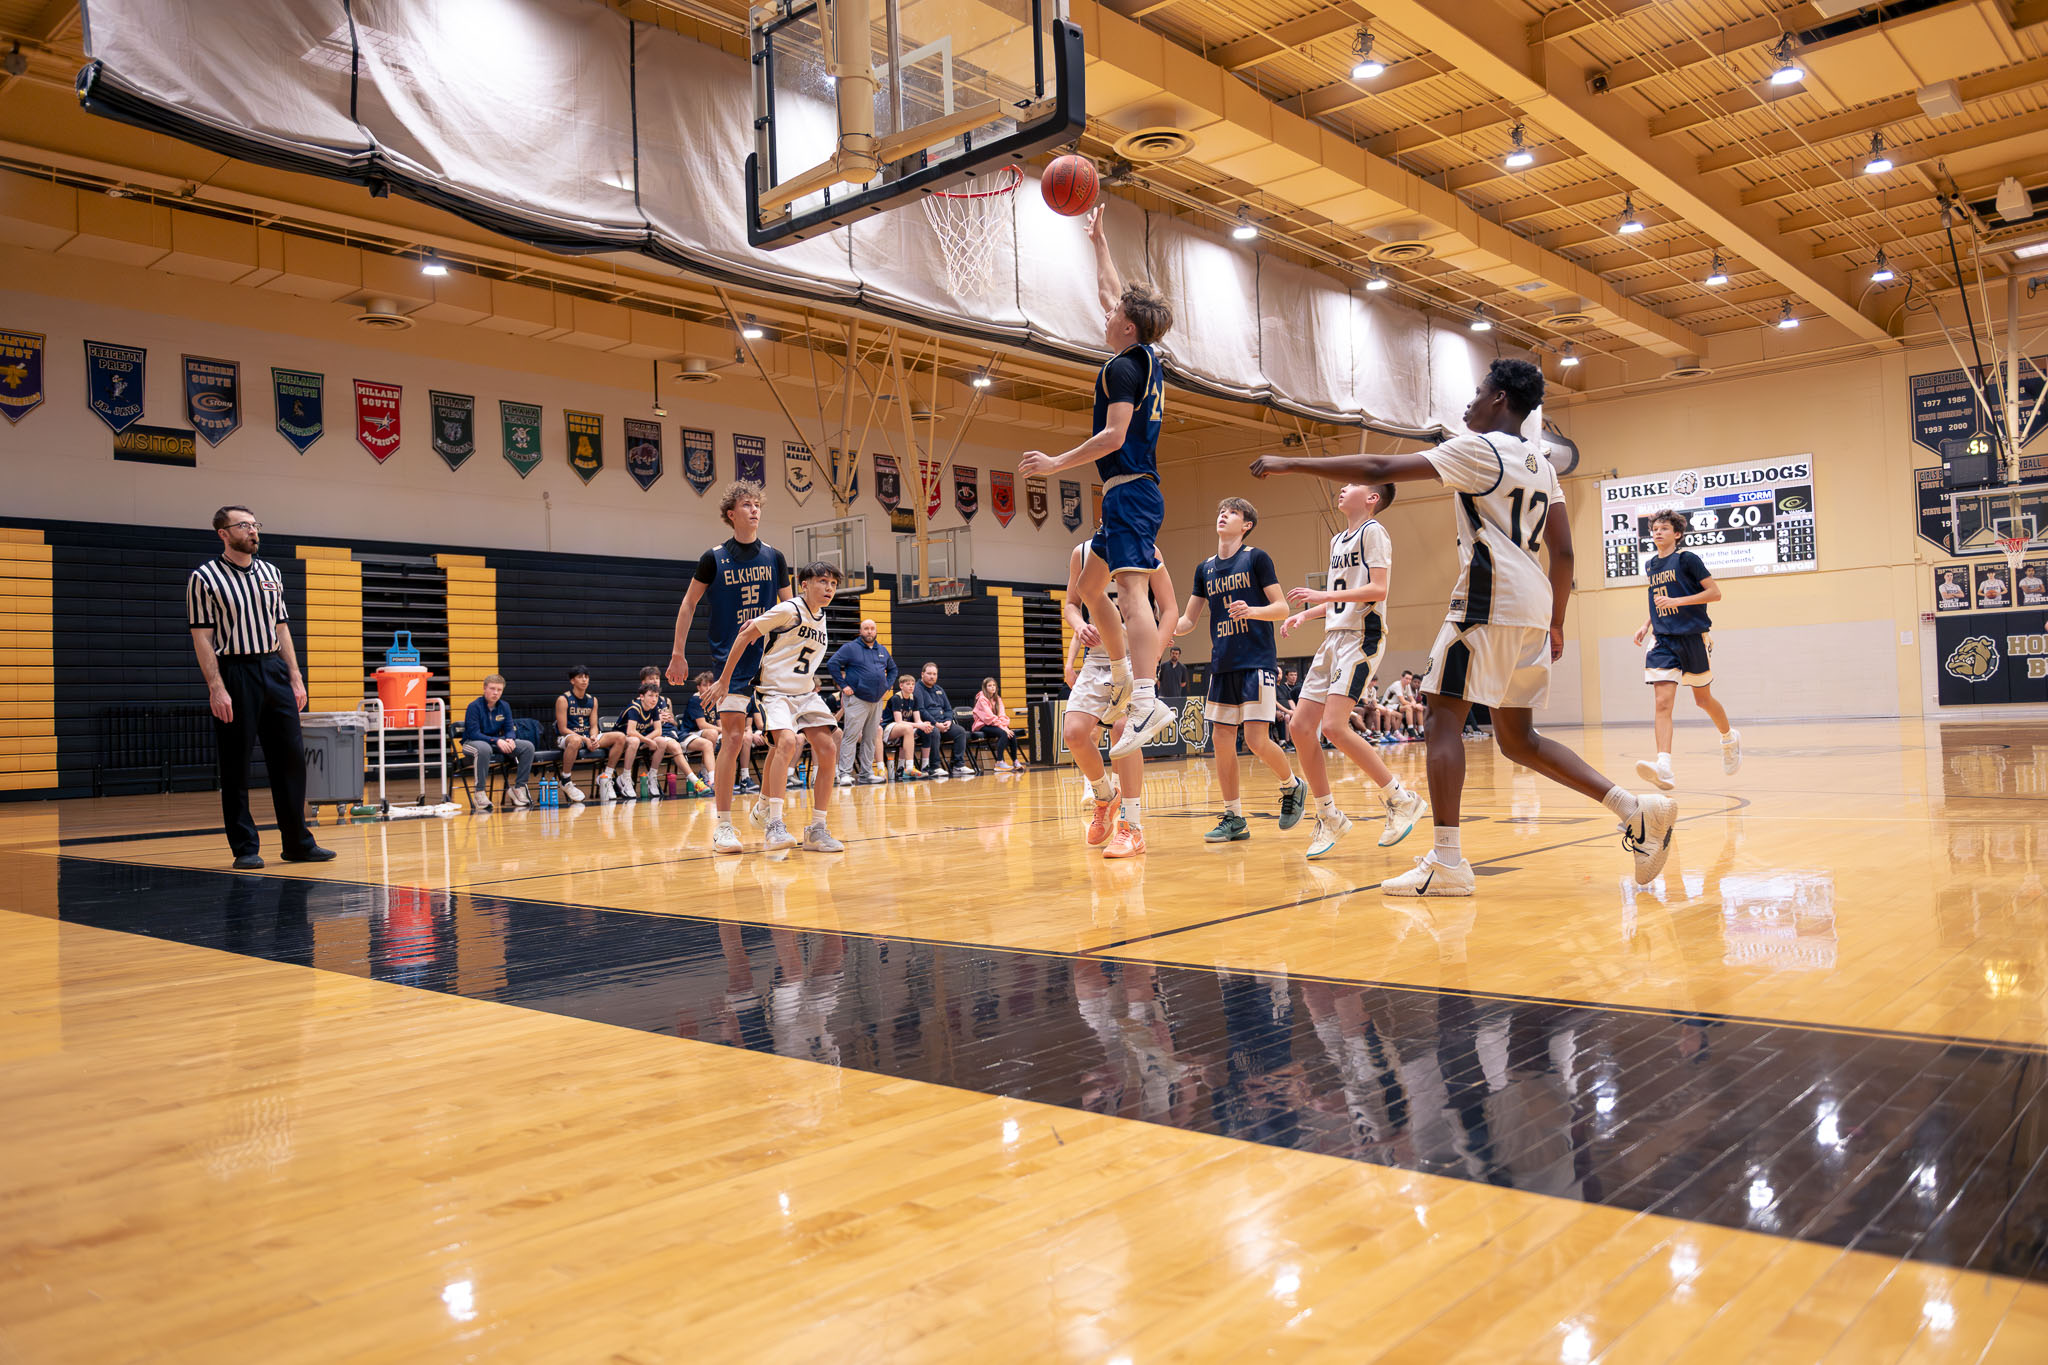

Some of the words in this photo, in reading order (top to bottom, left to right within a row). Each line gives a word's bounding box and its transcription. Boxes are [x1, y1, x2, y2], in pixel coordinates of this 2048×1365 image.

[90, 347, 142, 363] CREIGHTON
[99, 358, 133, 372] PREP
[188, 362, 235, 376] ELKHORN
[191, 374, 232, 387] SOUTH
[276, 374, 320, 387] MILLARD
[1933, 370, 1971, 385] BASKETBAL
[280, 385, 318, 398] NORTH
[358, 386, 399, 399] MILLARD
[95, 400, 112, 414] JR.
[113, 404, 140, 416] JAYS
[210, 399, 233, 408] STORM
[362, 398, 395, 409] SOUTH
[1922, 399, 1941, 408] 1977
[1948, 396, 1967, 404] 1986
[439, 407, 466, 419] WEST
[193, 414, 232, 429] STORM
[1924, 425, 1943, 434] 1993
[1948, 422, 1968, 431] 2000
[119, 433, 193, 454] VISITOR
[362, 431, 399, 447] PATRIOTS
[737, 439, 763, 448] OMAHA
[736, 448, 765, 457] CENTRAL
[1703, 464, 1808, 489] BULLDOGS
[1920, 470, 1937, 480] GIRLS
[1606, 481, 1668, 501] BURKE
[1921, 481, 1938, 490] STATE
[1738, 491, 1772, 502] STORM
[1728, 506, 1761, 528] 60
[1922, 507, 1941, 516] STATE
[1506, 487, 1549, 552] 12
[1700, 517, 1708, 528] 4
[1685, 531, 1726, 547] 03:56
[1759, 532, 1766, 540] 1
[1646, 543, 1654, 552] 3
[724, 565, 772, 586] ELKHORN
[1206, 571, 1251, 595] ELKHORN
[741, 584, 760, 606] 35
[1939, 601, 1969, 609] COLLINS
[1217, 618, 1249, 638] SOUTH
[798, 625, 826, 646] BURKE
[793, 646, 816, 675] 5
